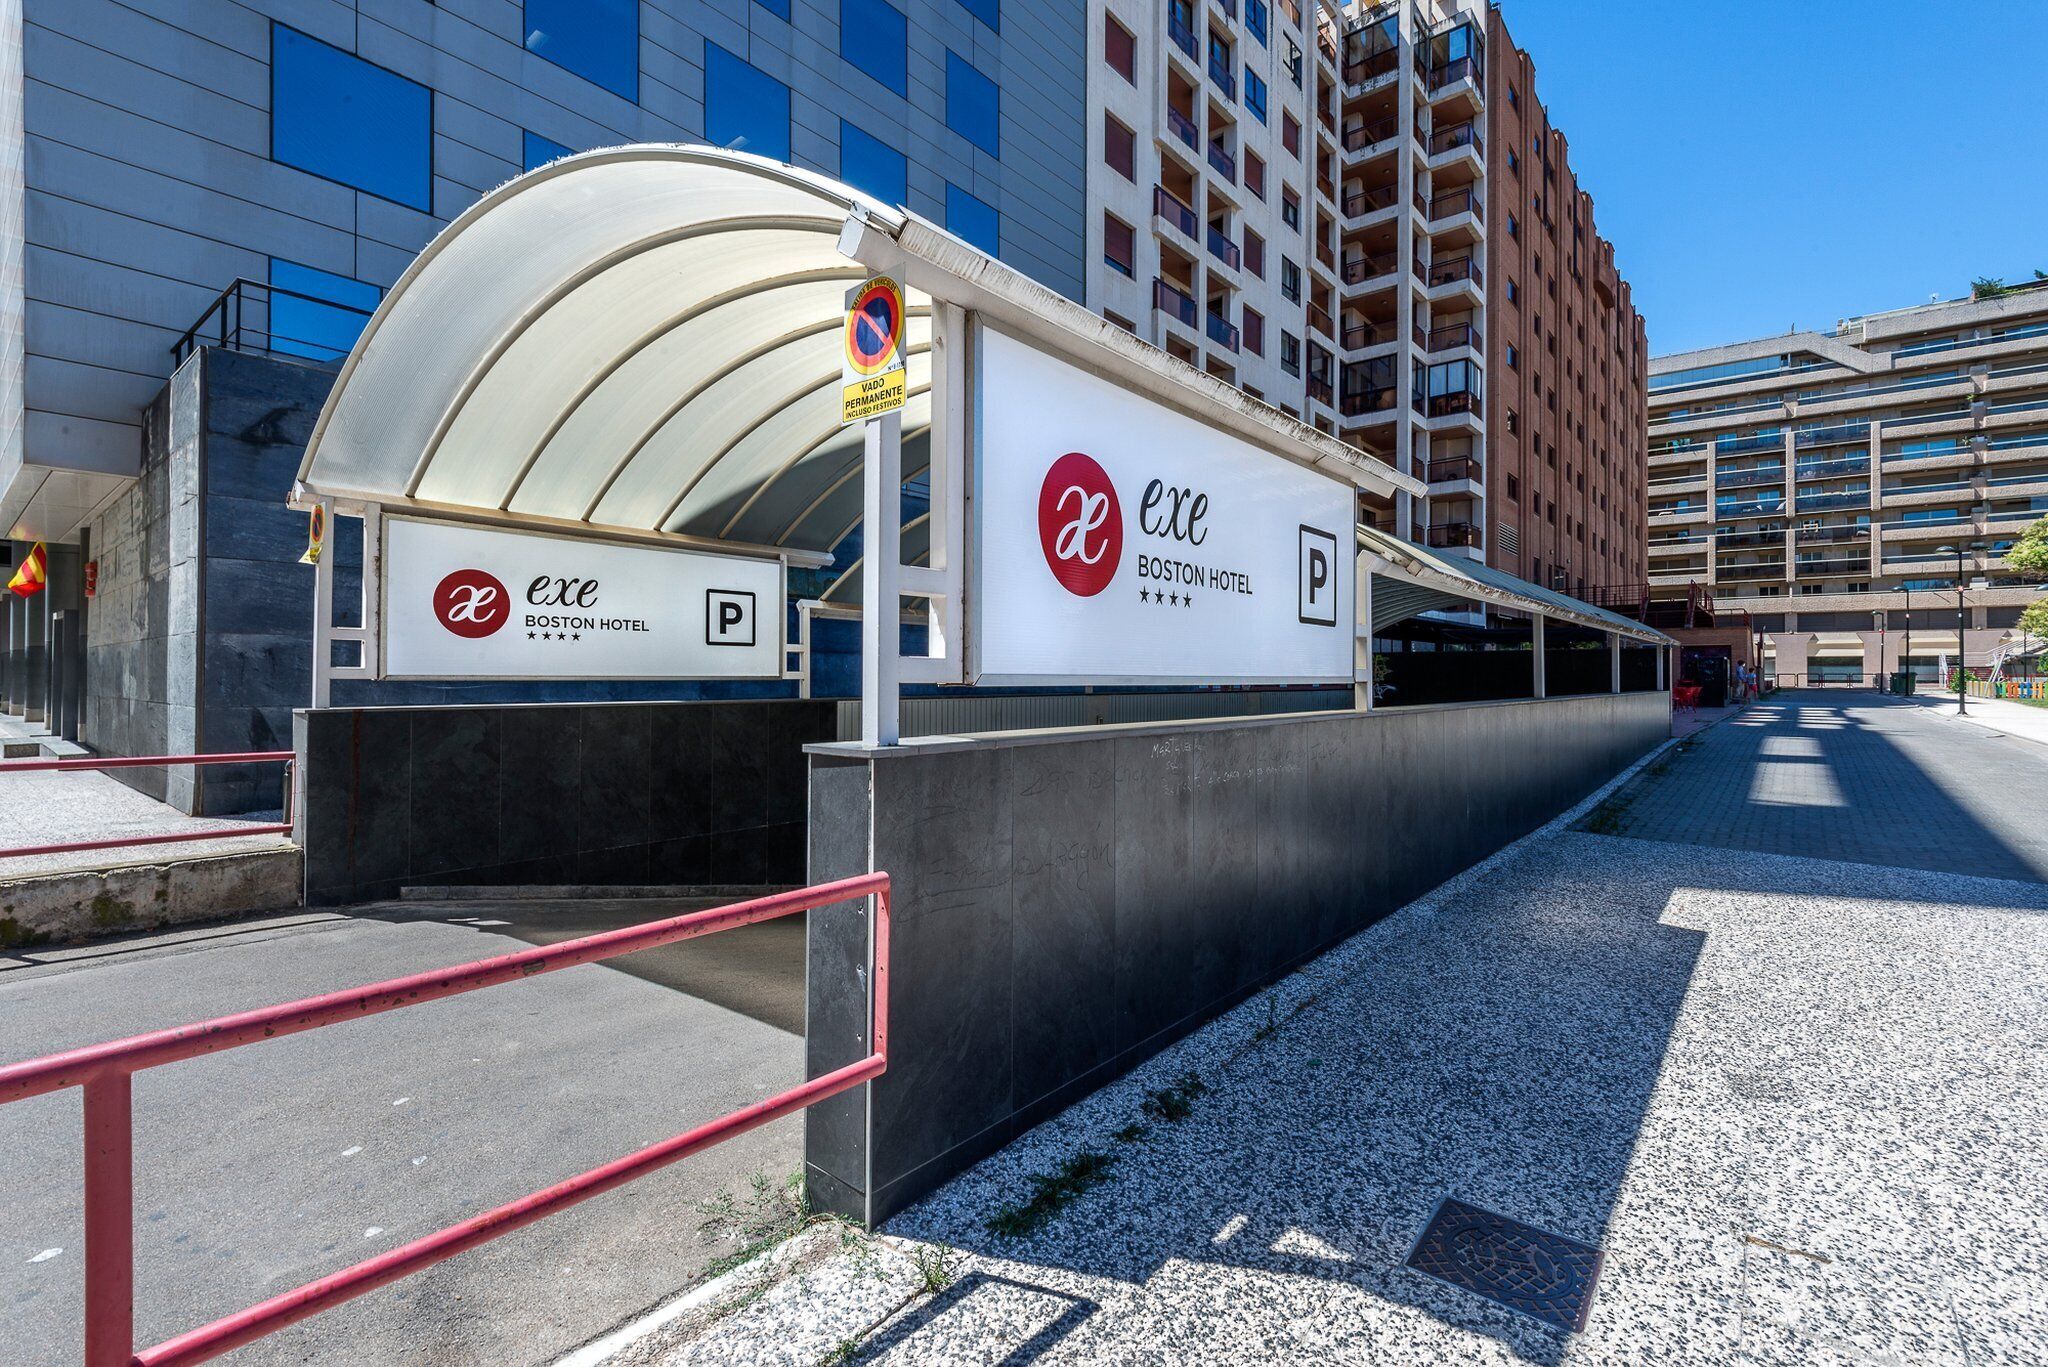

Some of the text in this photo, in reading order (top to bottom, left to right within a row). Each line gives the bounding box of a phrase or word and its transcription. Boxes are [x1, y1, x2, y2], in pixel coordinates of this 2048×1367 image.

[845, 385, 903, 410] PERMANENTE
[861, 378, 885, 393] VADO
[845, 397, 902, 419] INCLUSO FESTIVOS
[1139, 478, 1209, 546] exe
[1138, 554, 1253, 595] BOSTON HOTEL
[1309, 547, 1327, 604] P
[526, 575, 599, 608] exe
[525, 614, 650, 632] BOSTON HOTEL
[719, 601, 743, 634] P
